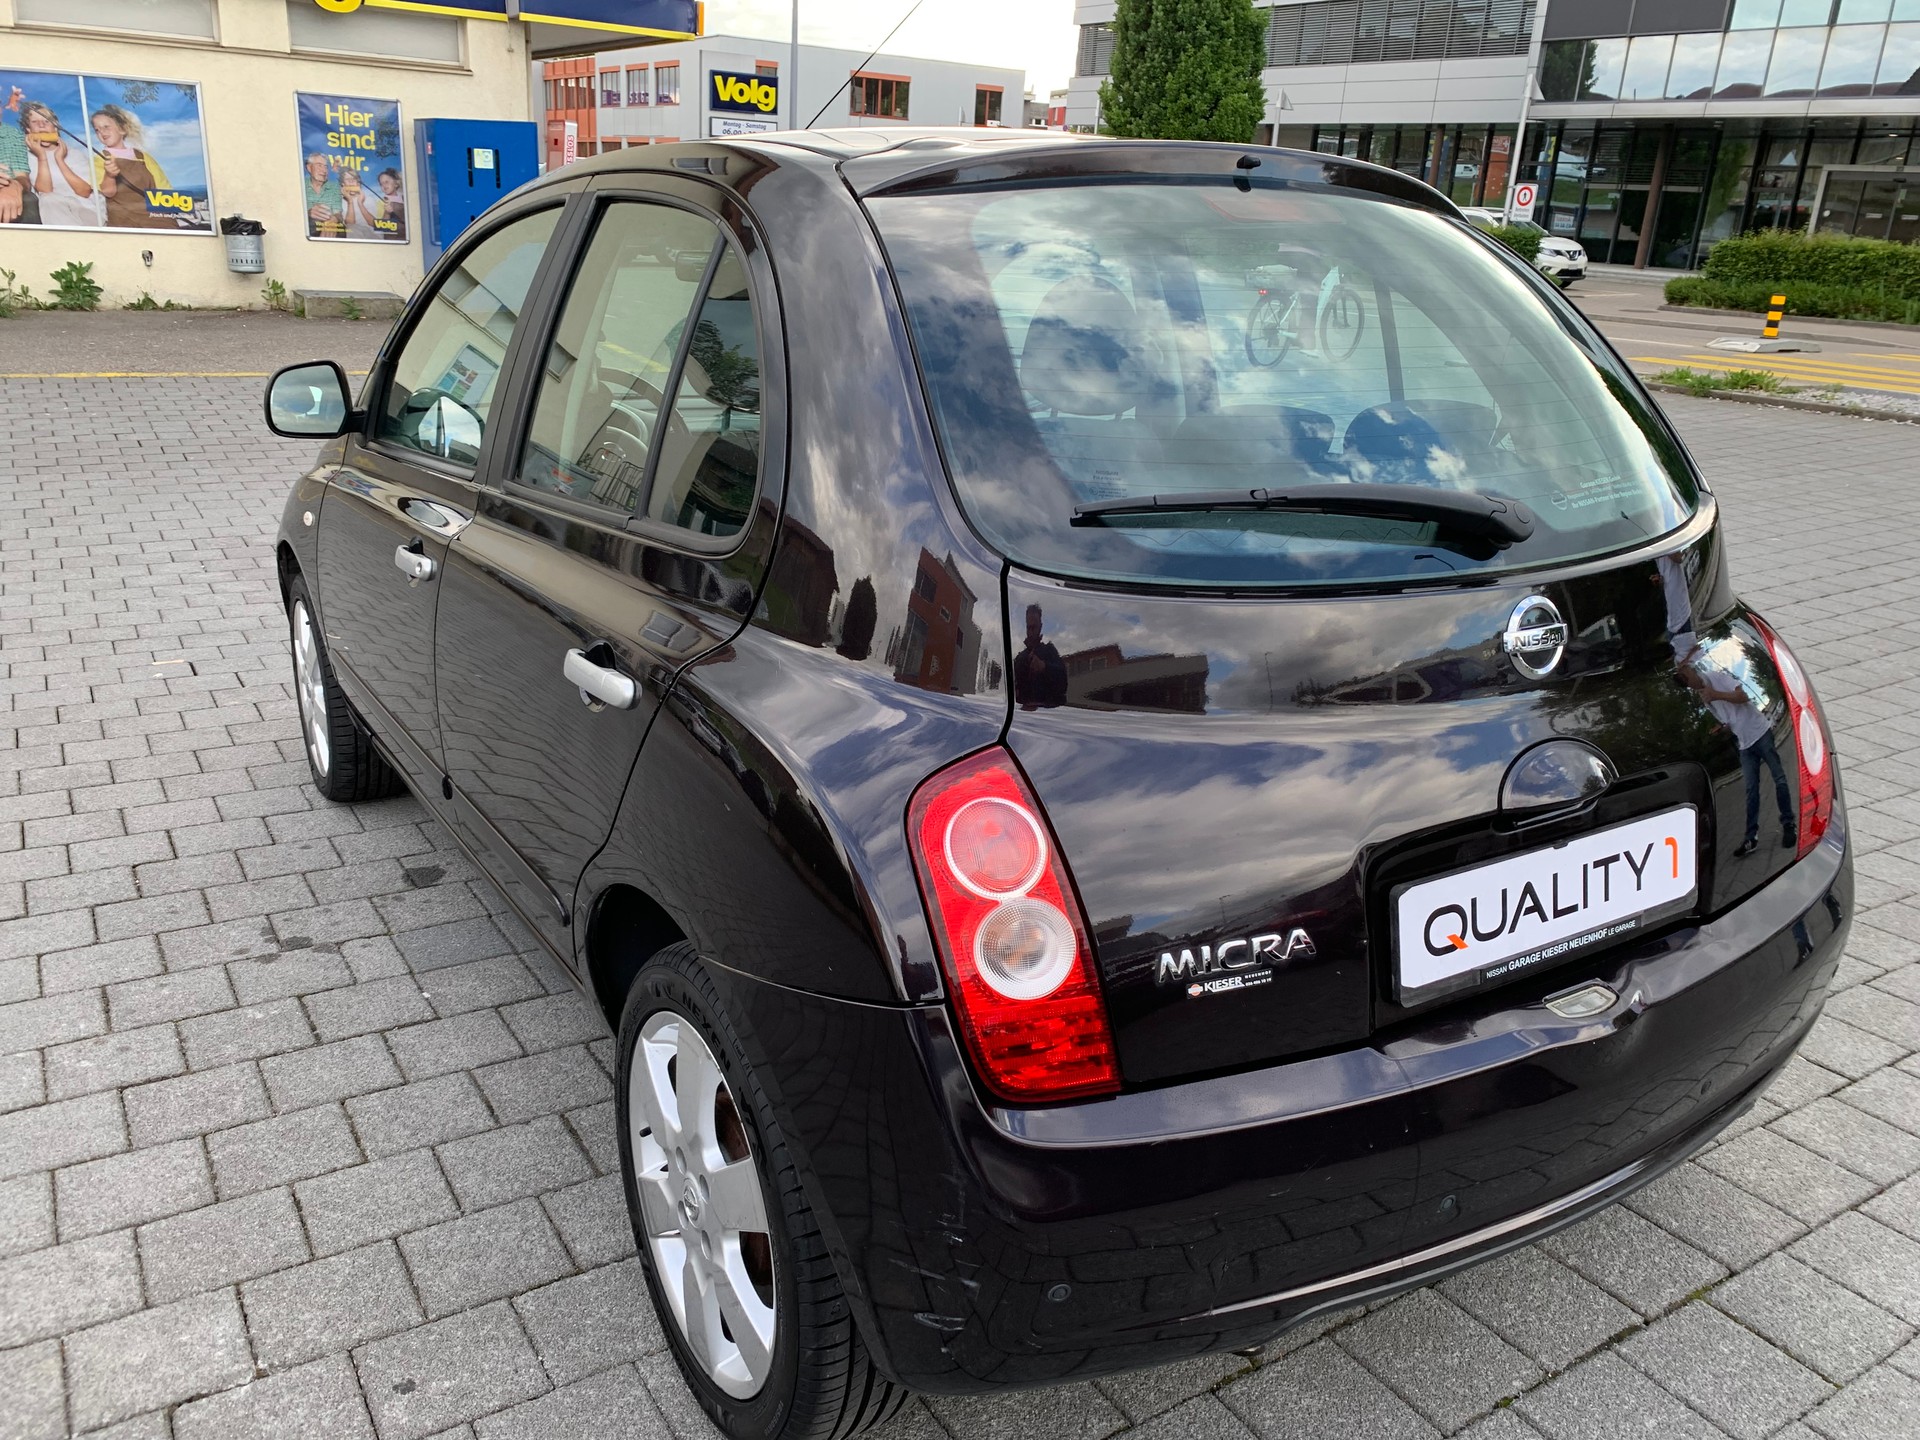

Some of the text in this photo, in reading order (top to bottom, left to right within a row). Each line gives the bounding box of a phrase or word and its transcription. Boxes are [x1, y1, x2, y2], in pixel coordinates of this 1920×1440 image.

[714, 75, 776, 112] Volg
[325, 104, 373, 127] Hier
[327, 127, 375, 150] sind
[566, 135, 574, 165] SSLOS
[328, 150, 369, 171] wir.
[146, 191, 193, 212] Volg
[374, 220, 397, 231] Volg
[1514, 630, 1564, 648] NISSAN
[1159, 928, 1316, 983] MICRA
[1486, 966, 1507, 978] NISSAN
[1508, 951, 1541, 970] GARAGE
[1542, 943, 1569, 959] KIESER
[1569, 929, 1607, 949] NEUENHOF
[1615, 920, 1636, 933] GARAGE
[1205, 976, 1242, 992] KIESER
[683, 992, 730, 1072] NEXEN
